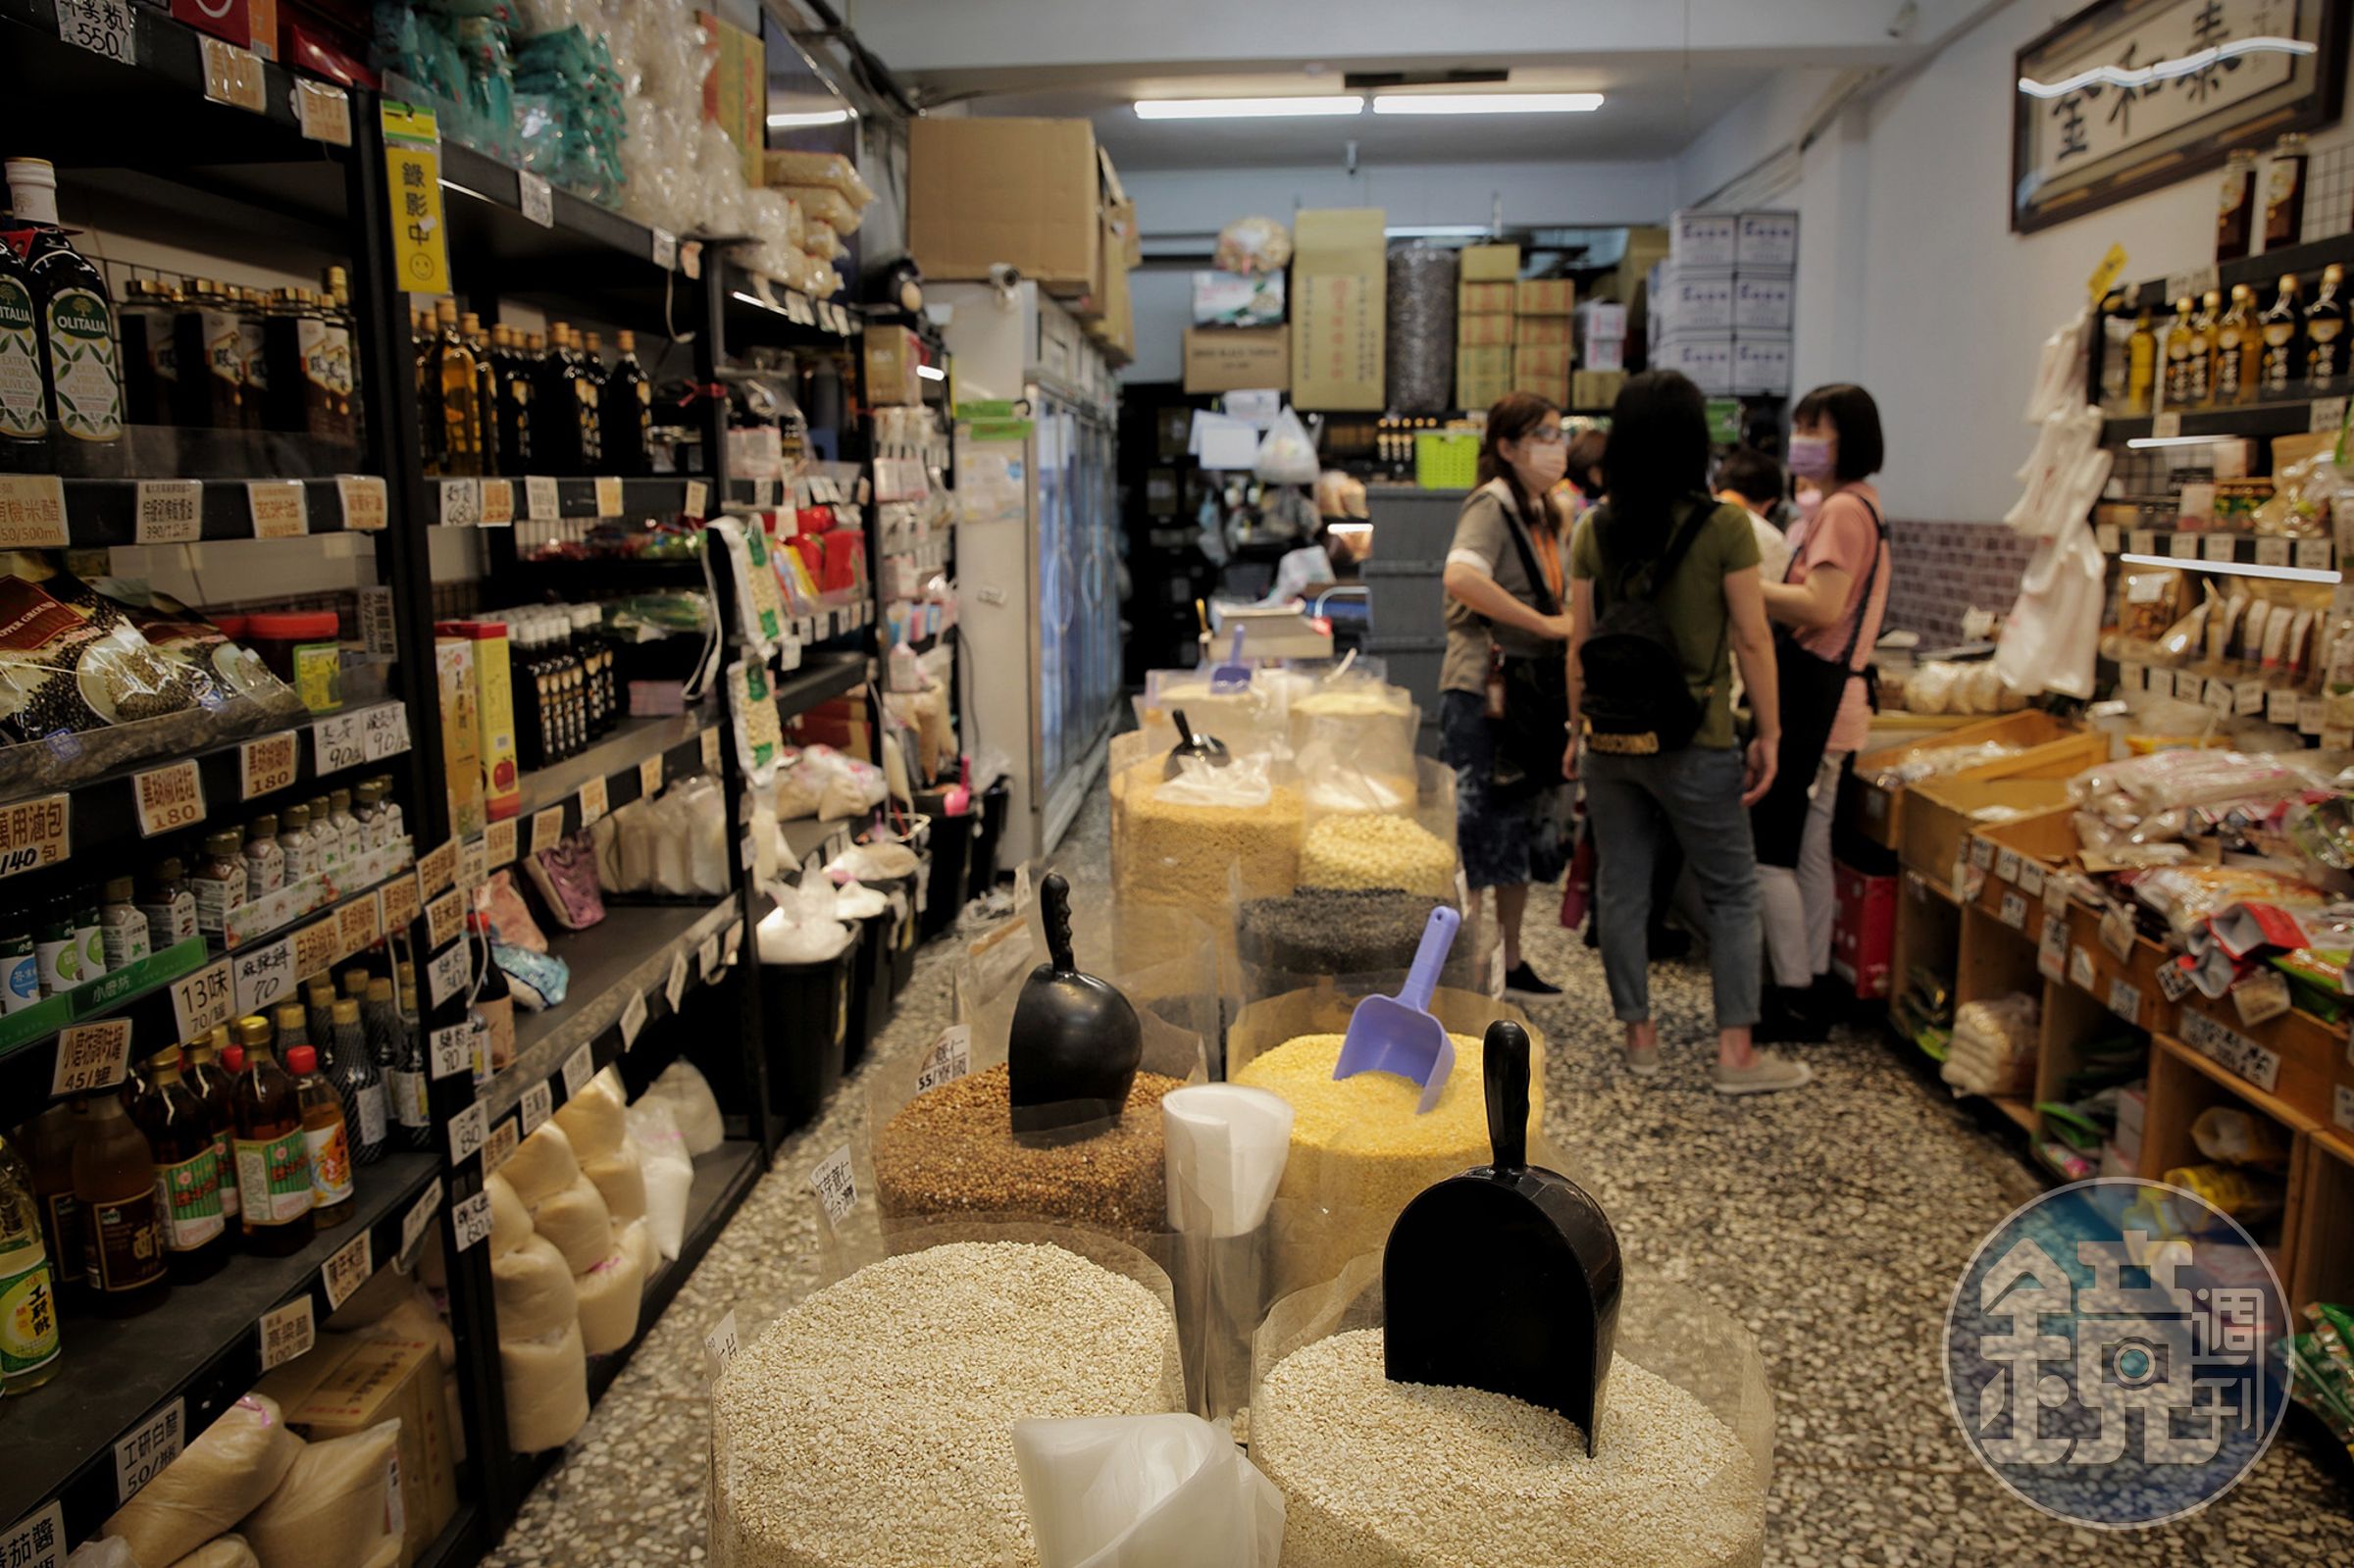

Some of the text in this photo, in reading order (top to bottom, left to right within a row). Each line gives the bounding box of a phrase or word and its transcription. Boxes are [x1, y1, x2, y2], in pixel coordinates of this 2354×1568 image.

[77, 23, 122, 58] 550
[56, 315, 107, 332] OLITALIA
[252, 771, 289, 794] 180
[152, 804, 197, 829] 180
[91, 975, 131, 1004] 小磨坊
[181, 969, 230, 1013] 13味
[253, 977, 280, 1005] 70
[28, 1284, 52, 1338] 工研醋
[123, 1410, 179, 1470] 工研白醋
